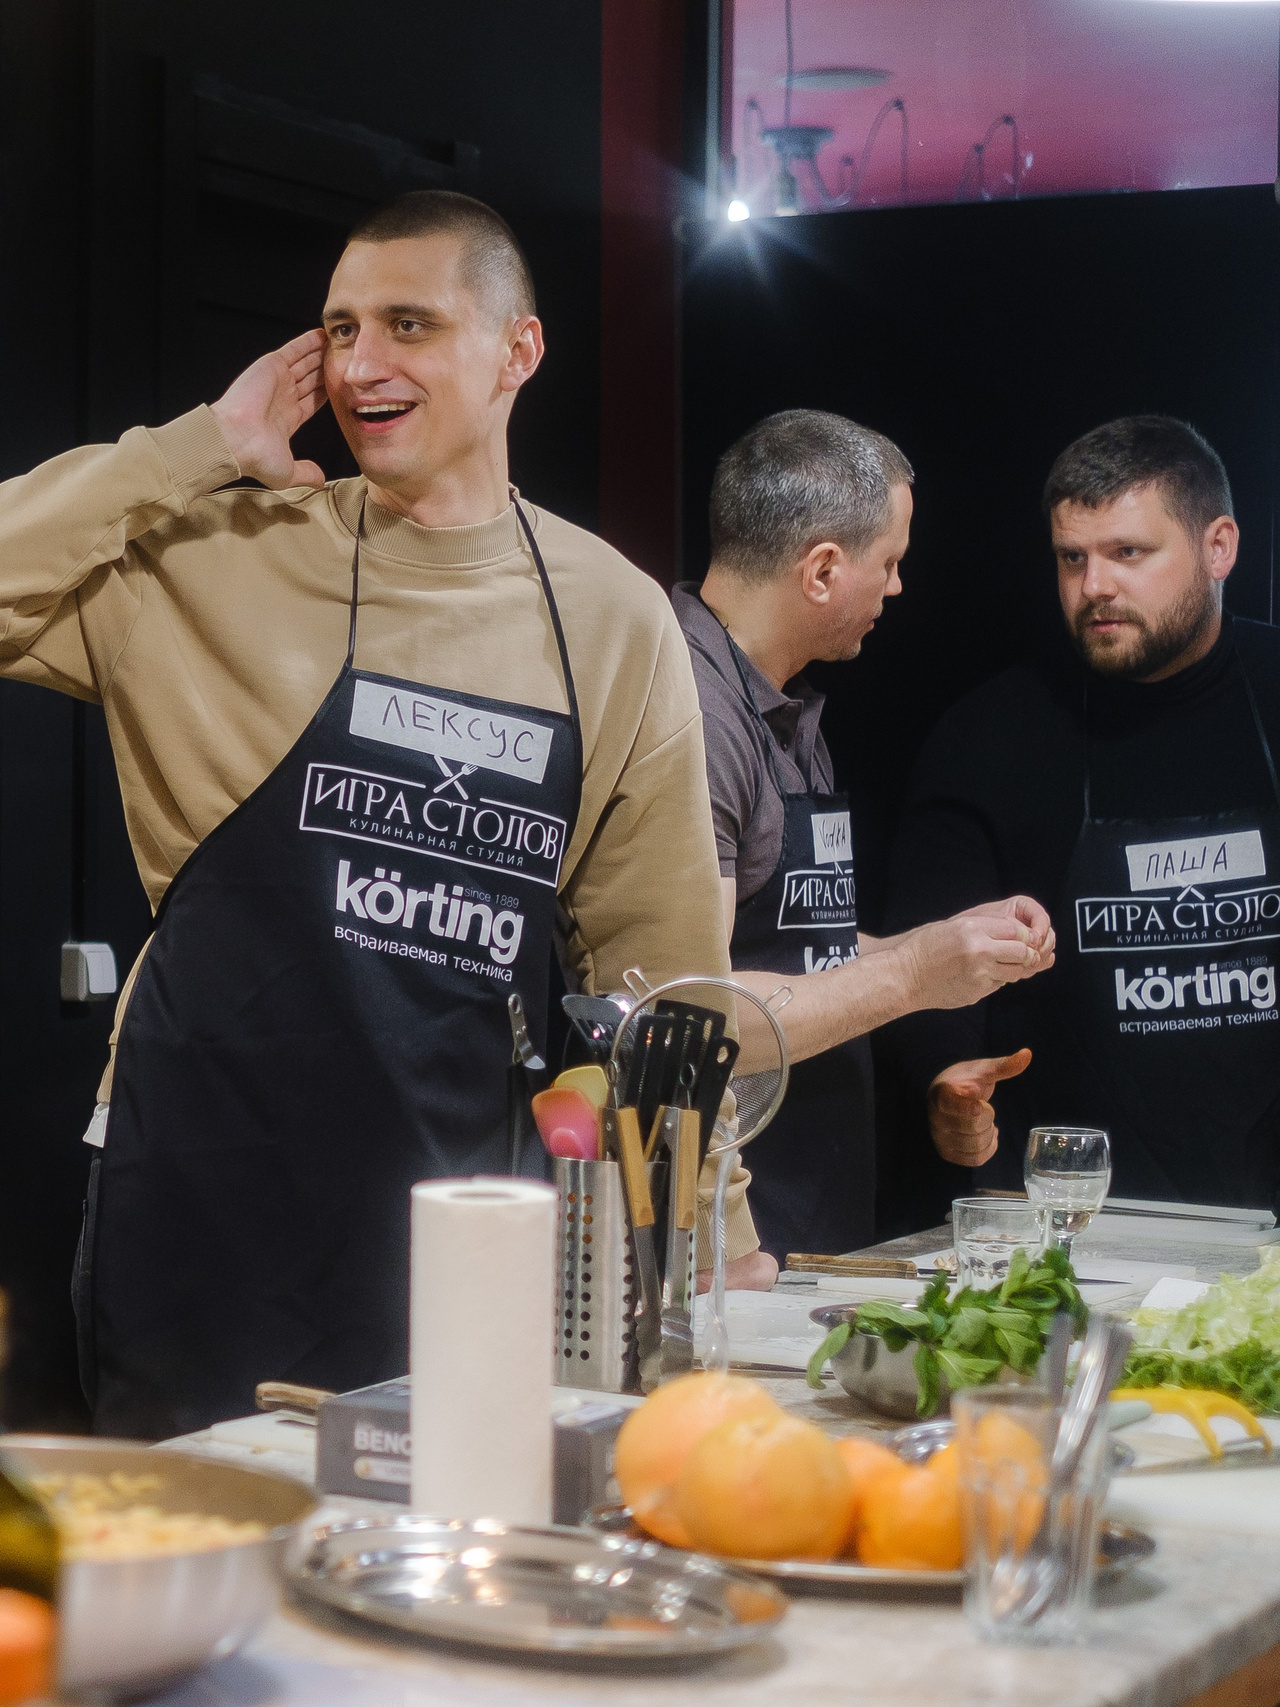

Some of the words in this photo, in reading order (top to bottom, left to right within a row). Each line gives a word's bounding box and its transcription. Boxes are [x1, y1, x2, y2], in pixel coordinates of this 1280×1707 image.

[382, 695, 534, 763] ЛЕКСУС
[315, 773, 411, 824] ИГРА
[422, 798, 559, 860] СТОЛОВ
[349, 819, 457, 851] КУЛИНАРНАЯ
[466, 845, 524, 867] СТУДИЯ
[1146, 842, 1228, 883] ПАША
[335, 860, 524, 965] körting
[464, 887, 491, 902] since
[496, 893, 520, 909] 1889
[789, 878, 833, 908] ИГРА
[1084, 905, 1165, 932] ИГРА
[1173, 893, 1280, 929] СТОЛО
[334, 926, 447, 965] встраиваемая
[453, 956, 513, 982] техника
[1117, 932, 1208, 944] КУЛИНАРНАЯ
[1215, 925, 1262, 939] СТУДИЯ
[1246, 956, 1268, 966] 1889
[1115, 963, 1276, 1011] körting
[1119, 1014, 1221, 1035] встраиваемая
[1226, 1009, 1278, 1026] техника
